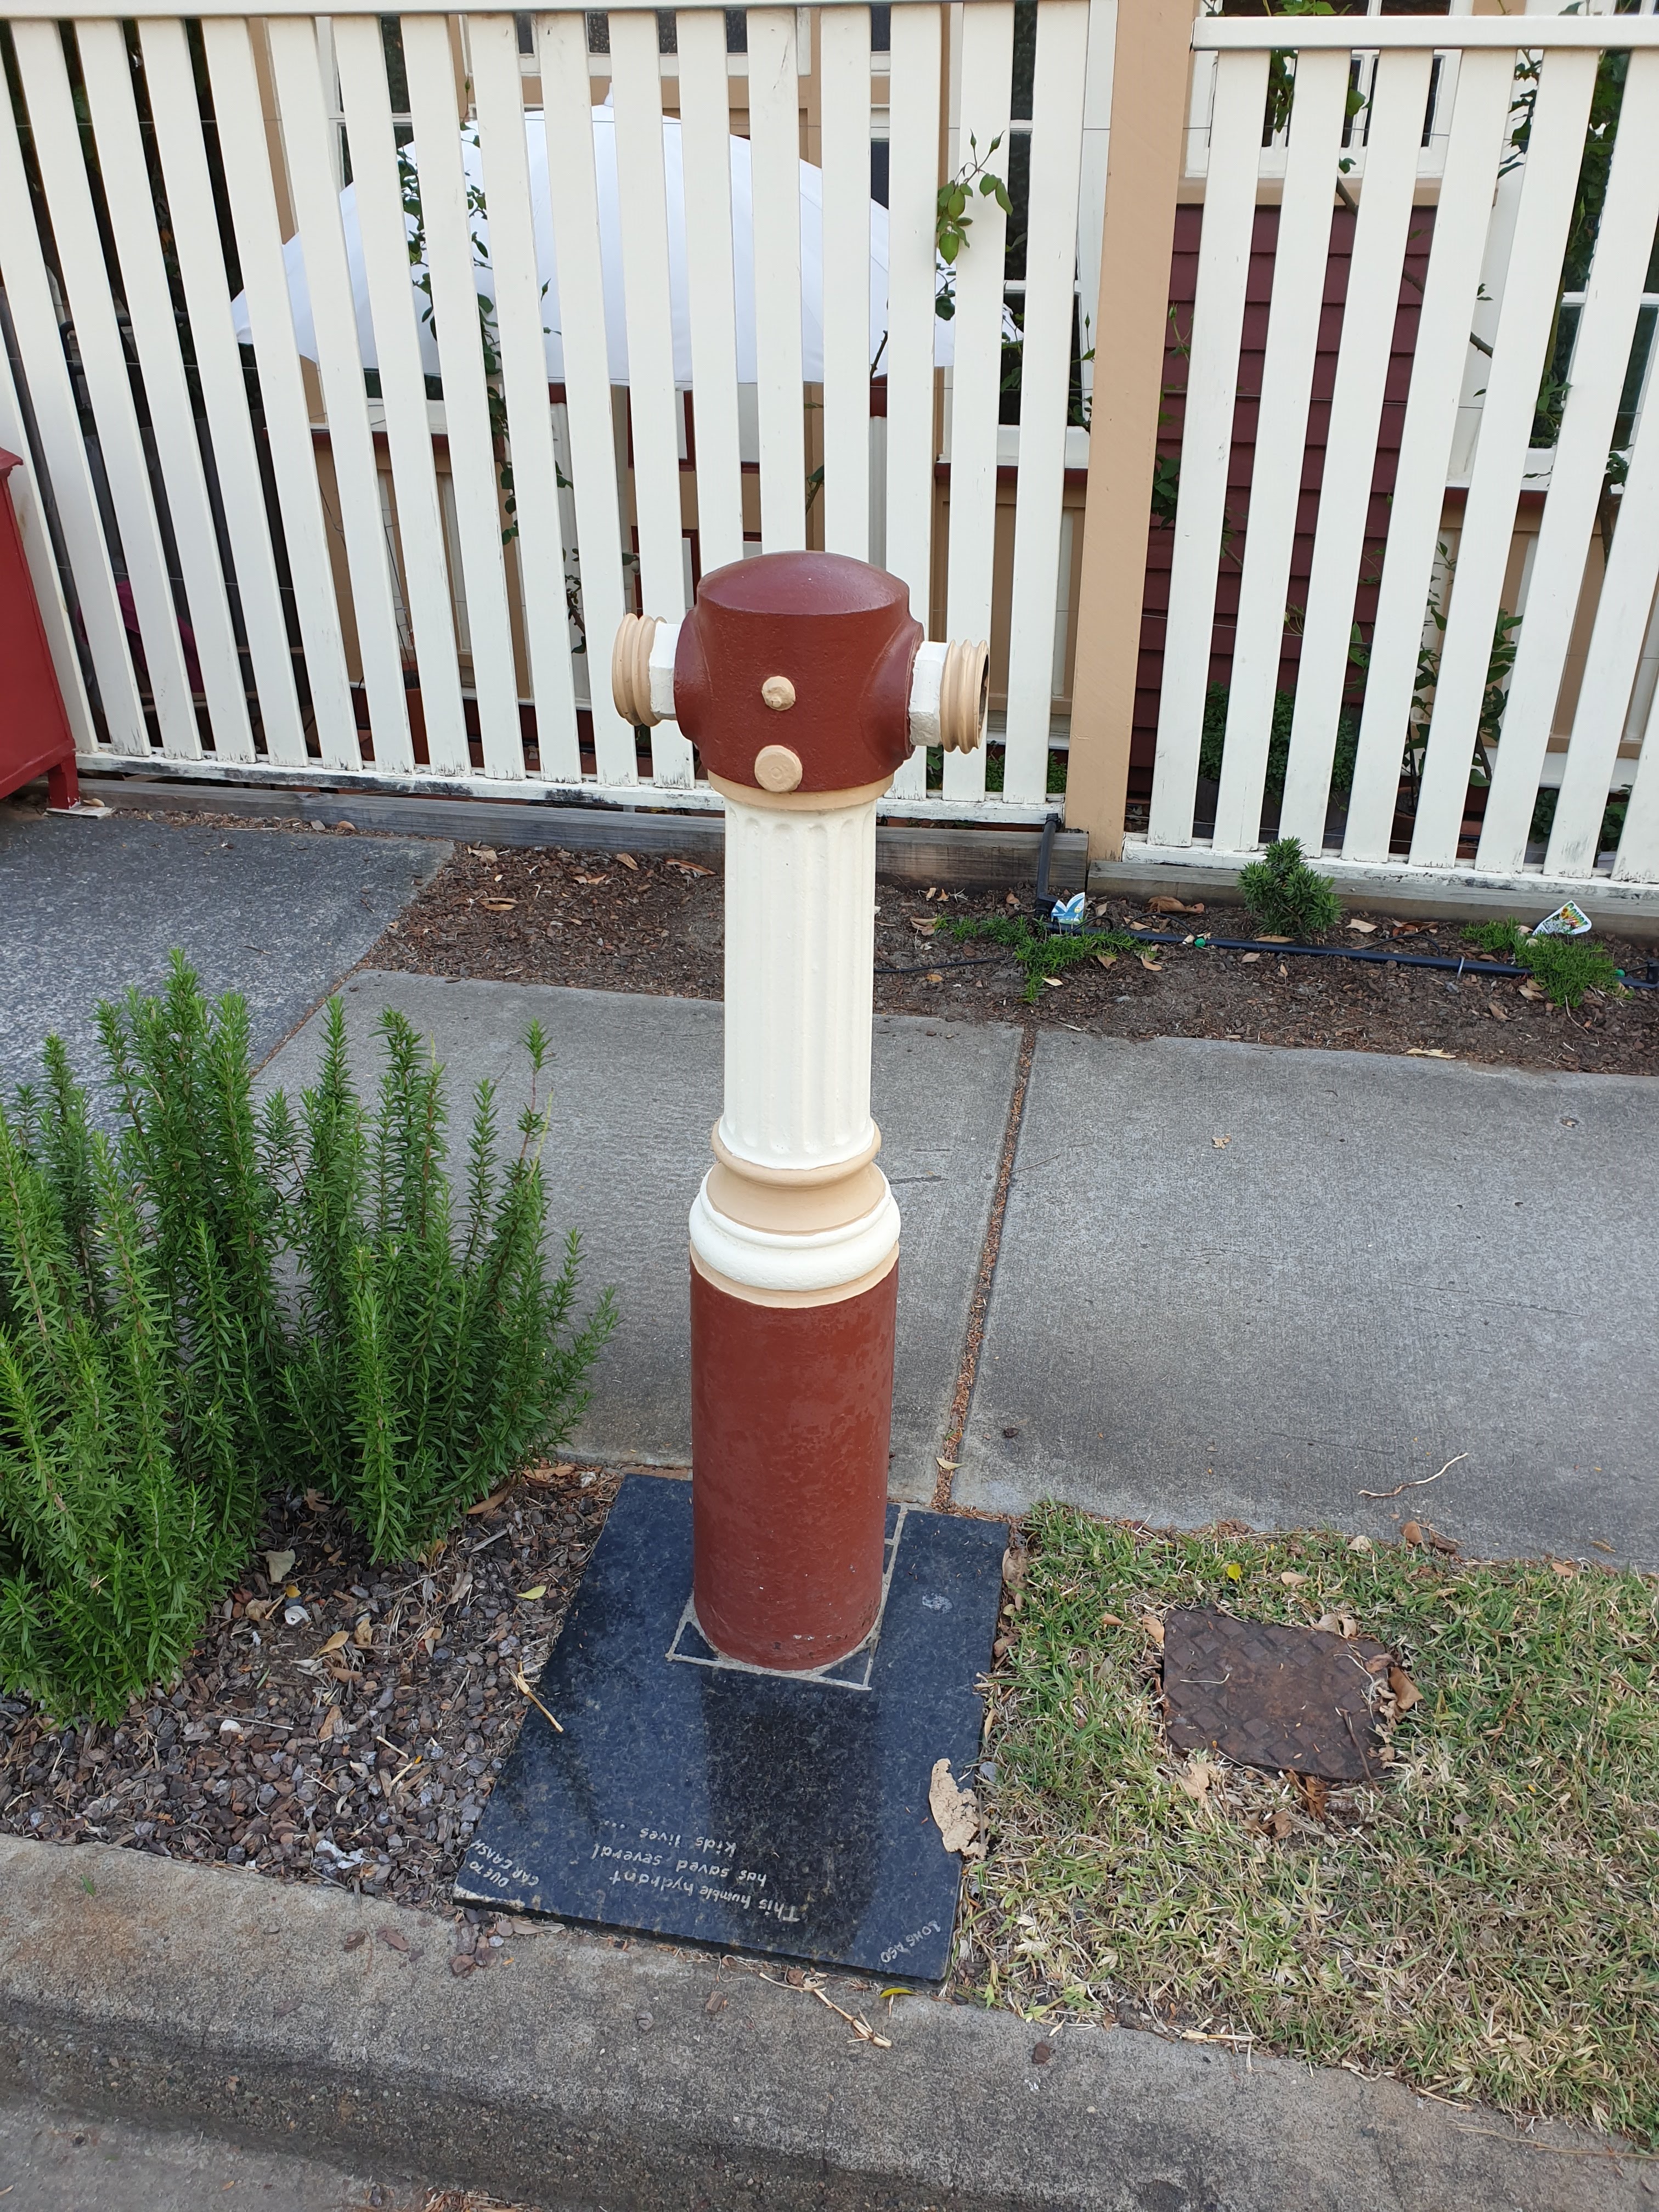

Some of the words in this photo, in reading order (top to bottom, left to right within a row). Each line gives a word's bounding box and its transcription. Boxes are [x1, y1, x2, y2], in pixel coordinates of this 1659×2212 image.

[639, 1827, 681, 1848] lives
[695, 1836, 737, 1858] kids
[470, 1838, 513, 1870] CRASH
[590, 1843, 663, 1865] several
[469, 1861, 484, 1875] TO
[483, 1867, 510, 1887] DUE
[511, 1866, 539, 1886] CAR
[675, 1859, 730, 1877] saved
[738, 1870, 767, 1887] has
[608, 1870, 694, 1897] hydrant
[699, 1885, 751, 1909] humble
[758, 1899, 800, 1922] This
[906, 1920, 941, 1947] LONG
